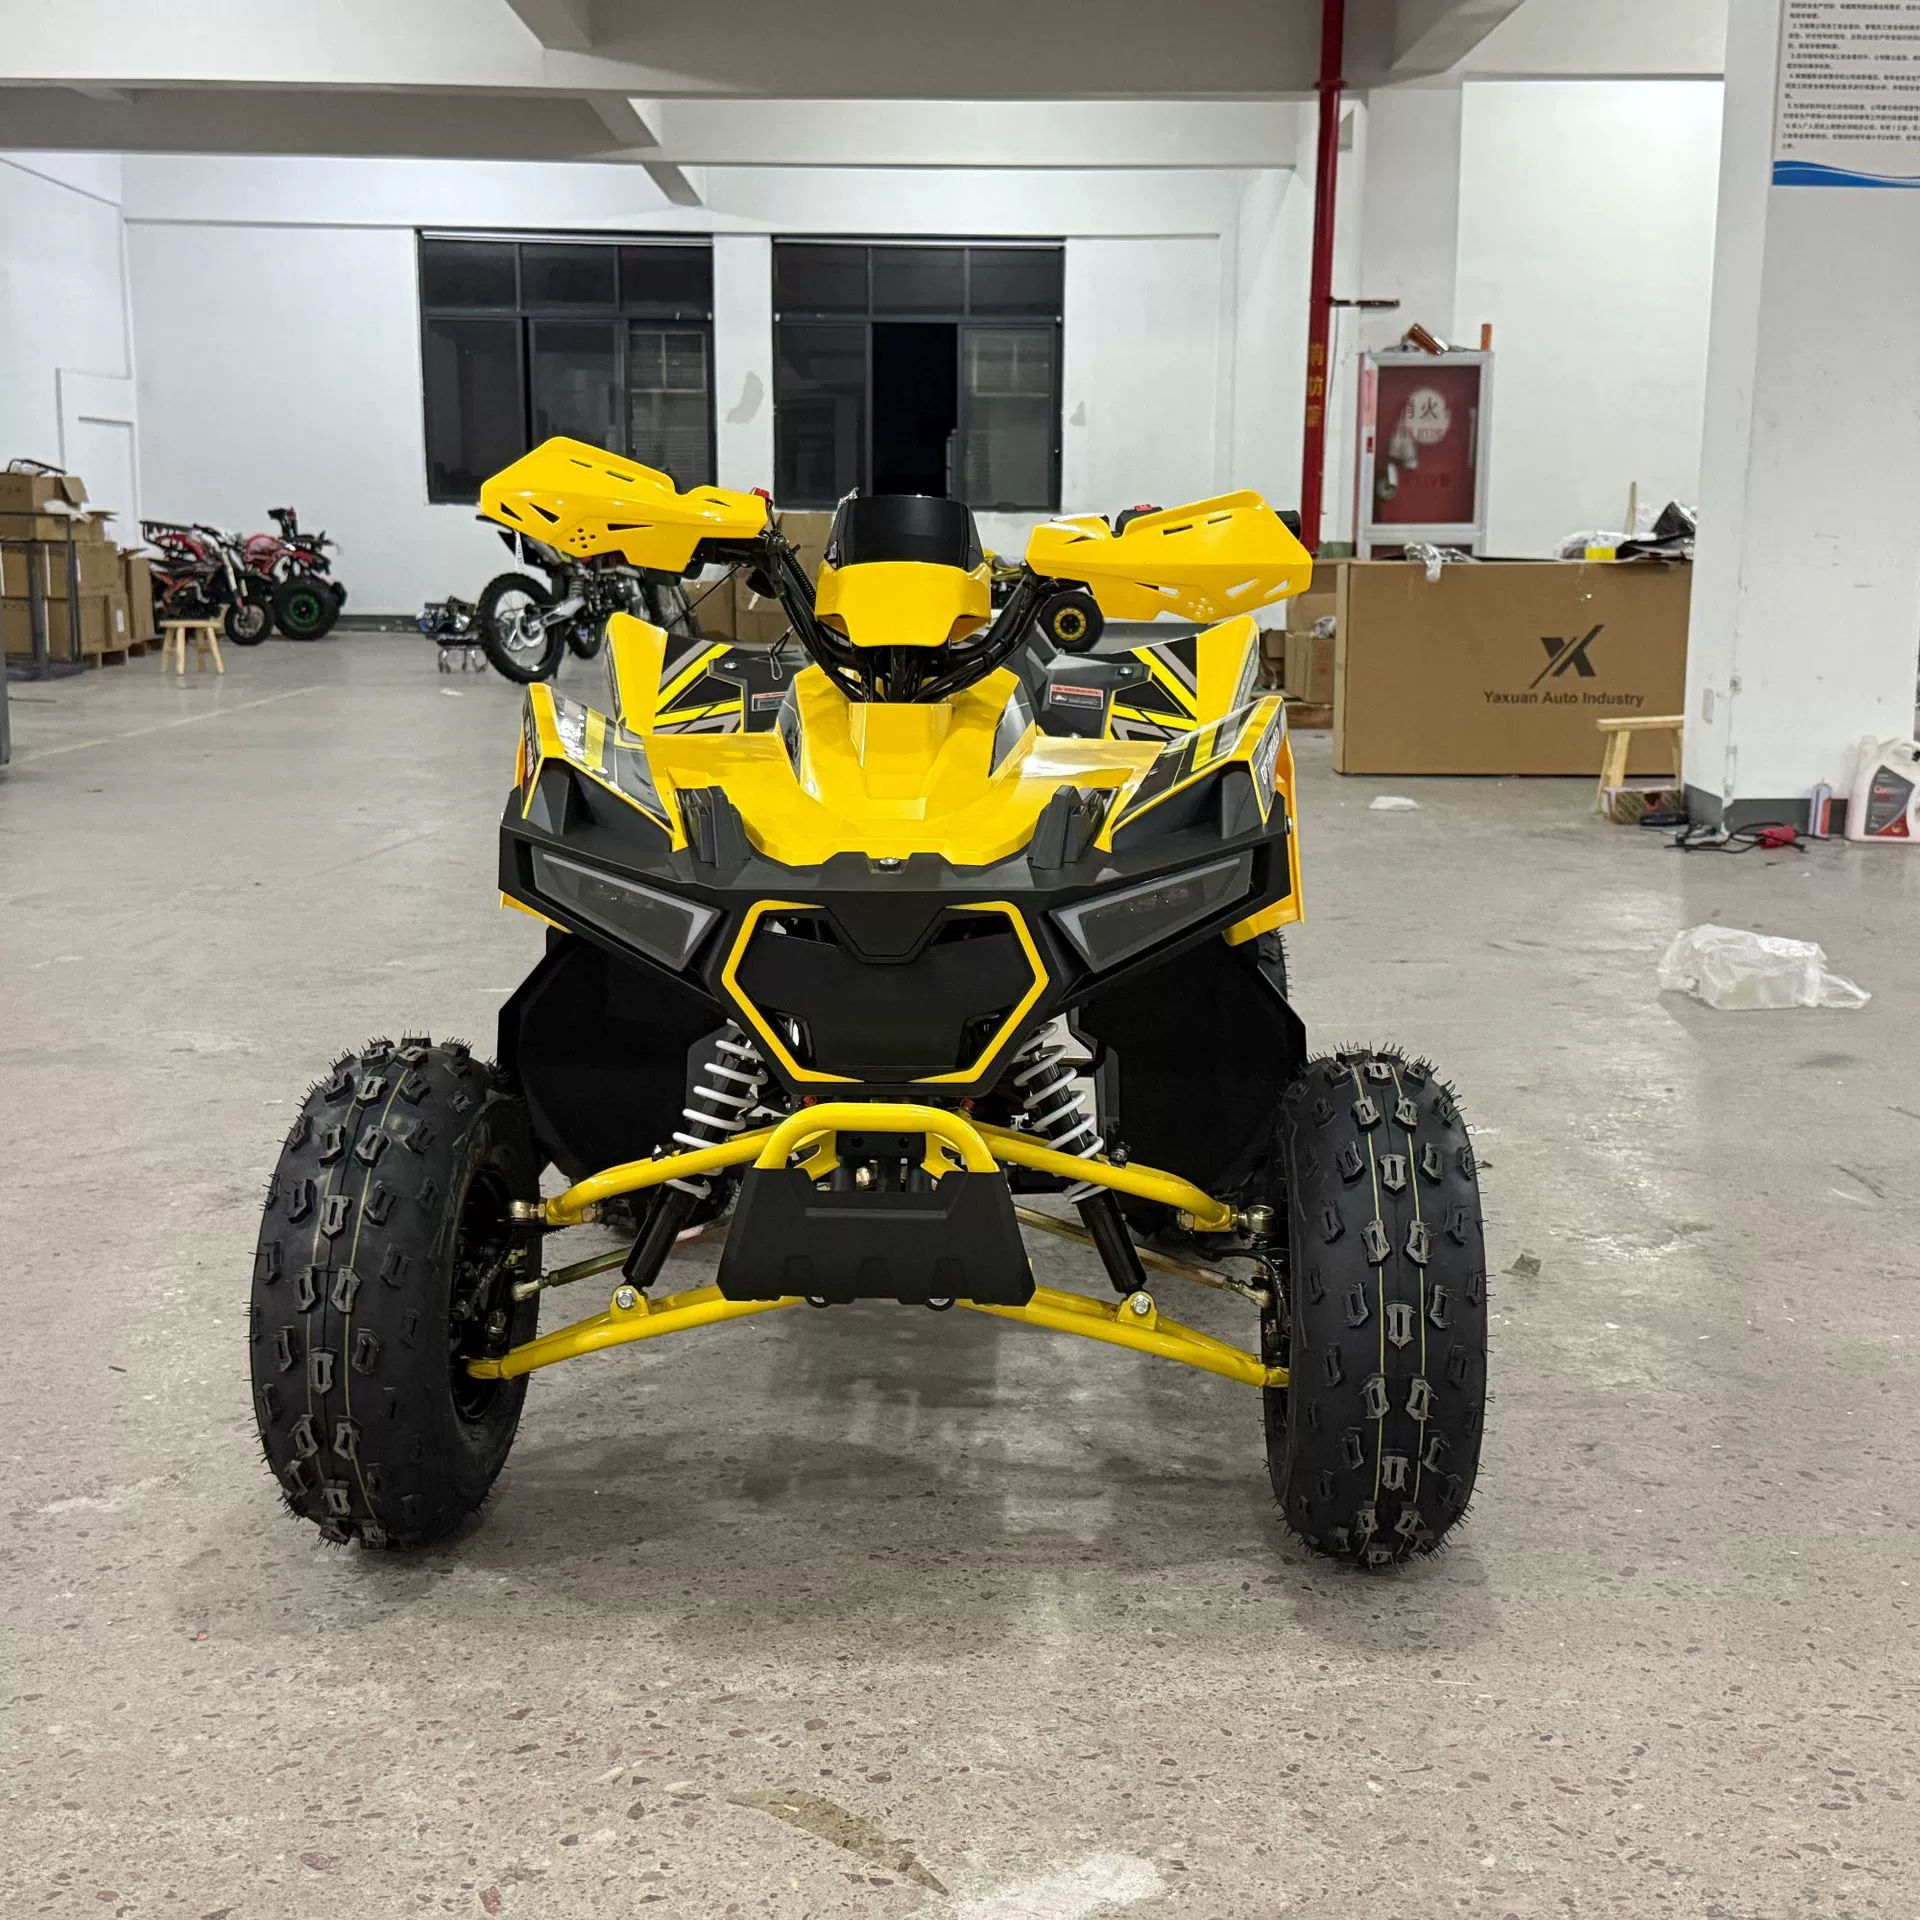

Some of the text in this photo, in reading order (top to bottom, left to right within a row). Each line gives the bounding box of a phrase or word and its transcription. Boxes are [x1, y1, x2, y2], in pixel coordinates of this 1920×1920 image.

[1484, 691, 1645, 708] Yaxuan Auto Industry
